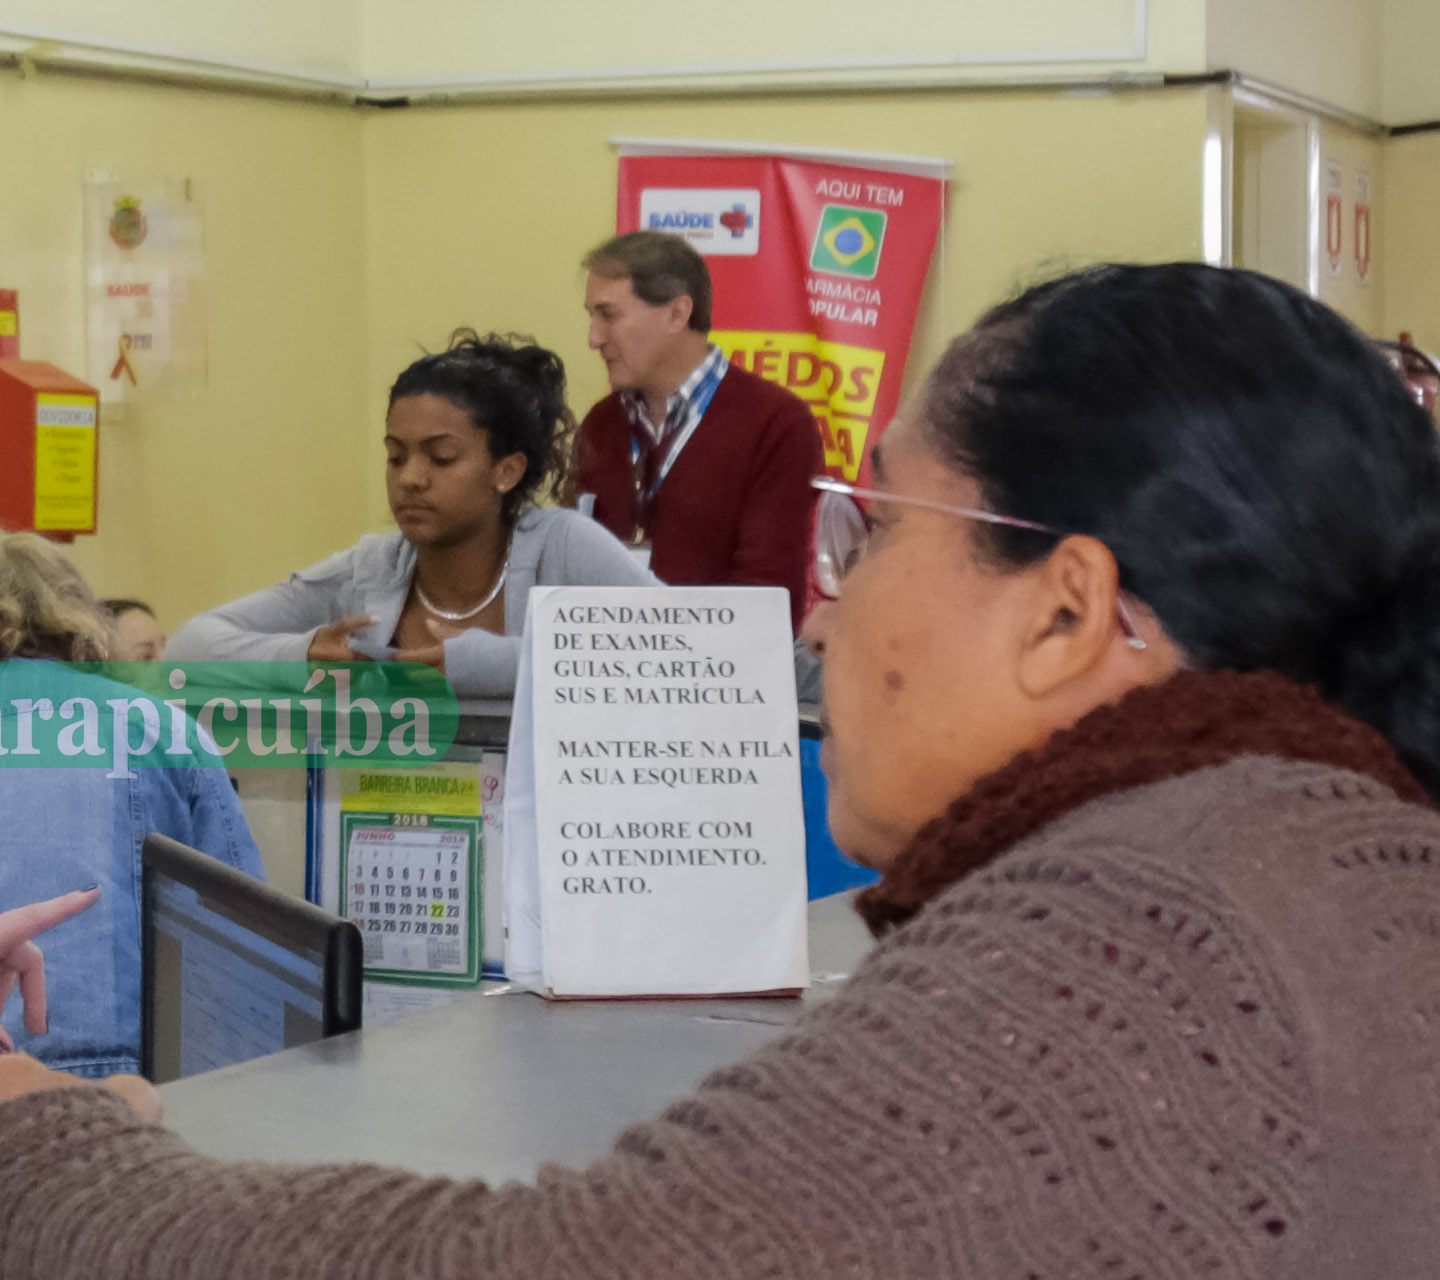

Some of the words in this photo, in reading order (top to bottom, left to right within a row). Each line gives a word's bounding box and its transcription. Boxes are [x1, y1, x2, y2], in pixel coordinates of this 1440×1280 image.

[815, 179, 862, 200] AQUI
[867, 186, 904, 206] TEM
[806, 277, 881, 306] ARMÁCIA
[553, 606, 735, 625] AGENDAMENTO
[553, 633, 584, 651] DE
[591, 633, 693, 653] EXAMES,
[554, 660, 631, 680] GUIAS,
[637, 656, 735, 679] CARTÃO
[555, 687, 596, 705] SUS
[604, 687, 617, 704] E
[624, 682, 766, 705] MATRÍCULA
[558, 740, 694, 758] MANTER-SE
[700, 740, 730, 758] NA
[739, 740, 793, 758] FILA
[359, 774, 411, 793] BARREIRA
[415, 776, 457, 795] BRANCA
[558, 768, 573, 785] A
[580, 768, 625, 785] SUA
[633, 767, 759, 789] ESQUERDA
[393, 814, 429, 827] 2018
[355, 830, 396, 841] JUNHO
[440, 832, 466, 844] 2018
[561, 821, 690, 840] COLABORE
[698, 821, 753, 839] COM
[436, 851, 442, 863] 1
[451, 852, 459, 864] 2
[562, 849, 578, 867] O
[586, 849, 767, 867] ATENDIMENTO.
[356, 865, 363, 878] 3
[371, 866, 378, 878] 4
[387, 866, 394, 879] 5
[402, 867, 410, 880] 6
[419, 868, 425, 881] 7
[434, 869, 441, 882] 8
[450, 870, 458, 882] 9
[354, 882, 365, 895] 10
[369, 883, 380, 897] 11
[385, 884, 396, 897] 12
[401, 885, 412, 898] 13
[416, 886, 428, 899] 14
[432, 887, 443, 900] 15
[448, 888, 460, 901] 16
[563, 876, 652, 895] GRATO.
[354, 901, 365, 913] 17
[369, 902, 380, 915] 18
[385, 902, 396, 915] 19
[400, 903, 413, 916] 20
[416, 904, 428, 917] 21
[431, 904, 445, 918] 22
[447, 905, 460, 919] 23
[368, 919, 382, 932] 25
[384, 920, 396, 932] 26
[400, 921, 411, 933] 27
[415, 921, 428, 934] 28
[430, 923, 443, 935] 29
[445, 923, 459, 936] 30
